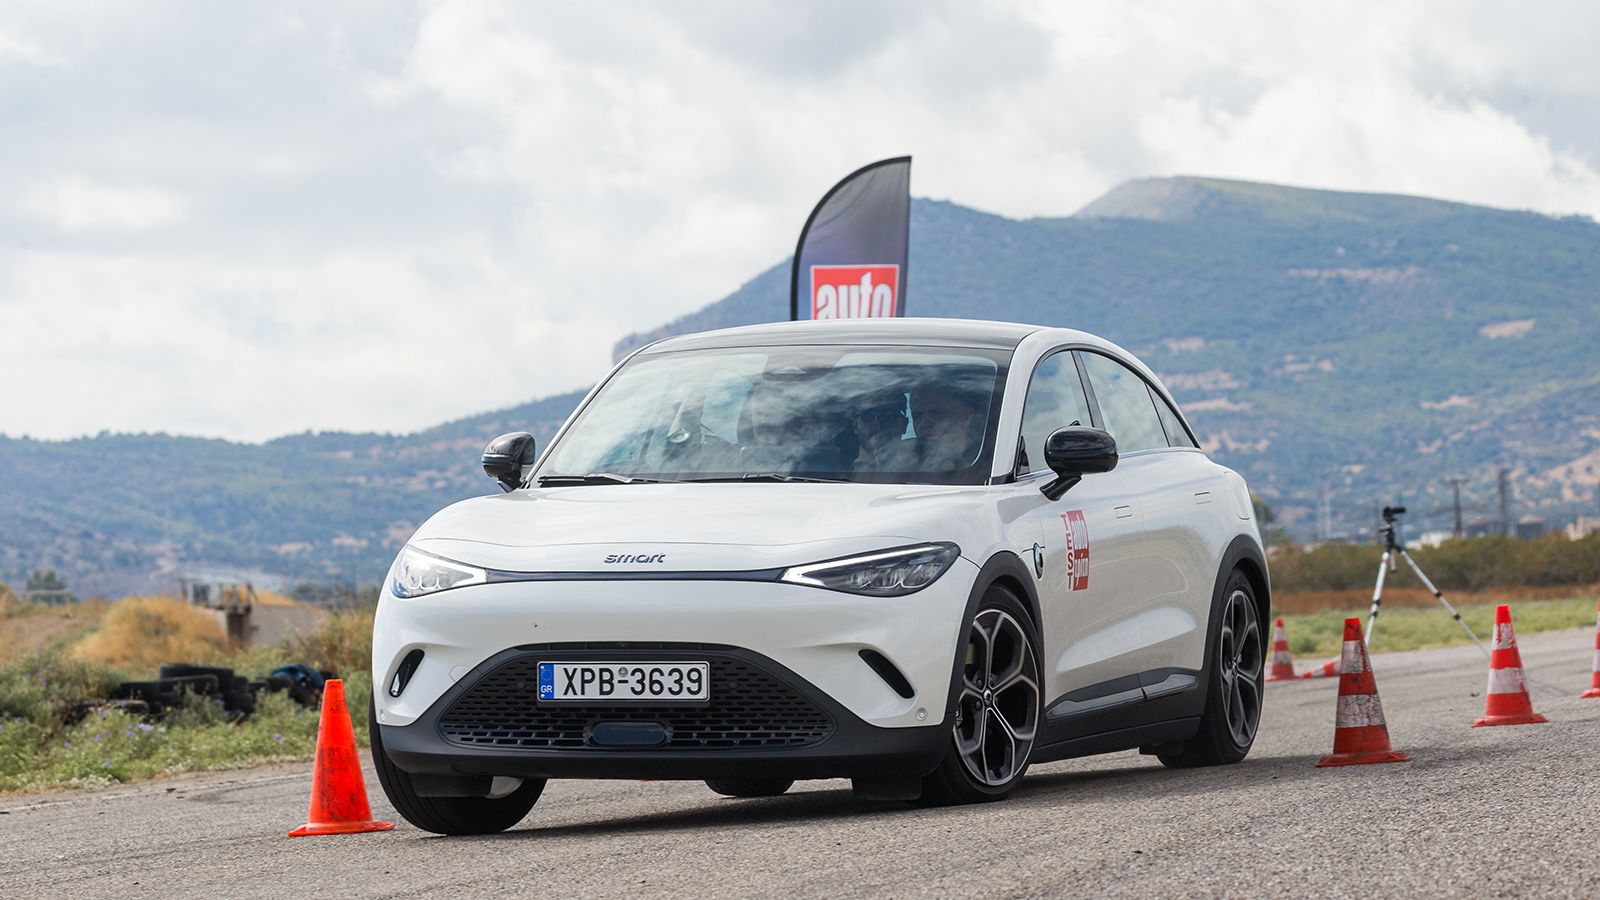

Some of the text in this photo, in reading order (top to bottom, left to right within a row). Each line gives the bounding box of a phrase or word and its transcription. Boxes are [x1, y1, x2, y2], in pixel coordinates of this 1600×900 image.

[816, 271, 892, 319] auto
[603, 553, 666, 564] smart
[1060, 513, 1074, 590] TEST
[540, 685, 553, 693] GR
[562, 667, 703, 696] XPB-3639
